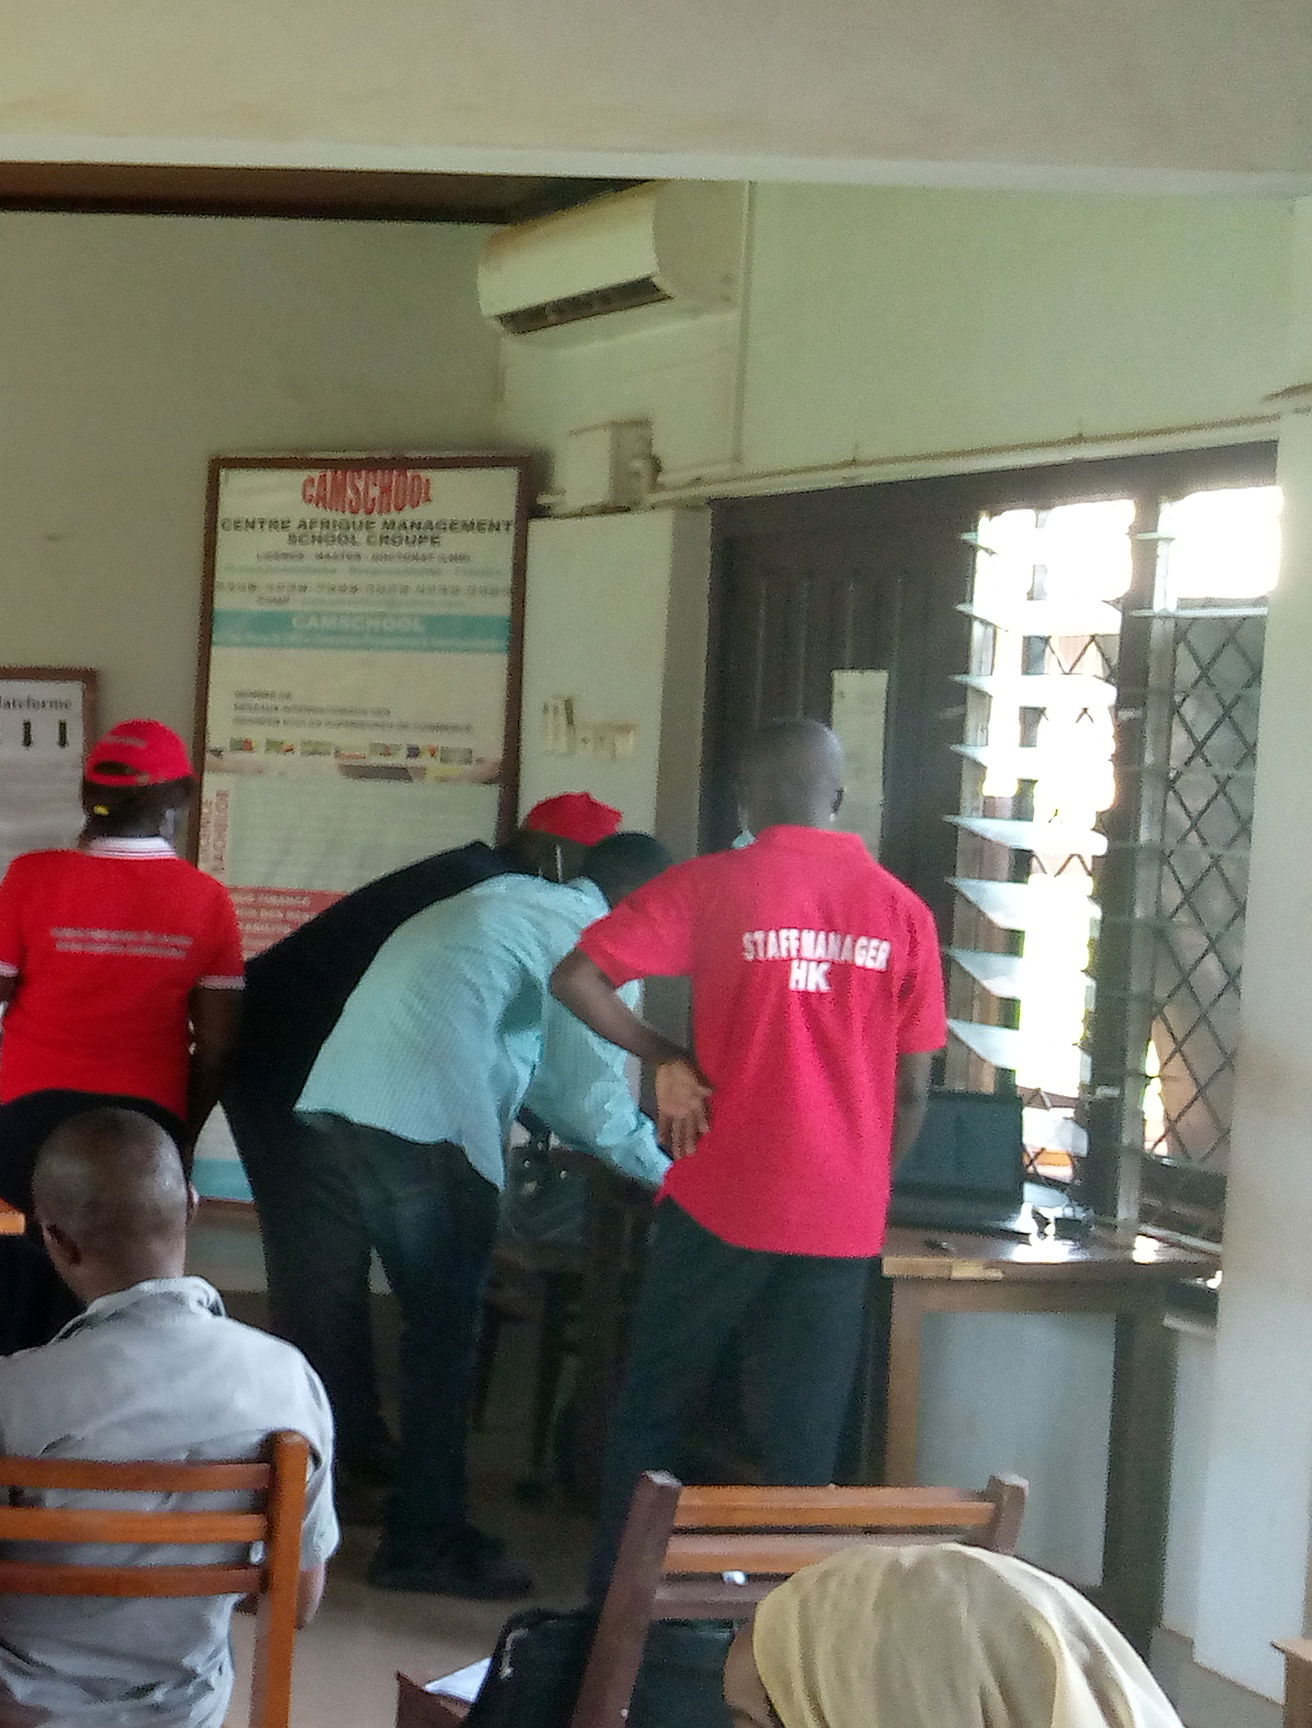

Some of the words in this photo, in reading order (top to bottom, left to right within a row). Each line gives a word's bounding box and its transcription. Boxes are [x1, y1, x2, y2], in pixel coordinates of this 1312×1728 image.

[302, 468, 433, 516] CAMSCHOOL
[221, 518, 291, 533] CENTRE
[297, 519, 376, 533] AFRIQUE
[381, 519, 513, 534] MANAGEMENT
[287, 533, 360, 547] SCHOOL
[366, 534, 441, 548] GROUPE
[788, 959, 832, 993] HK
